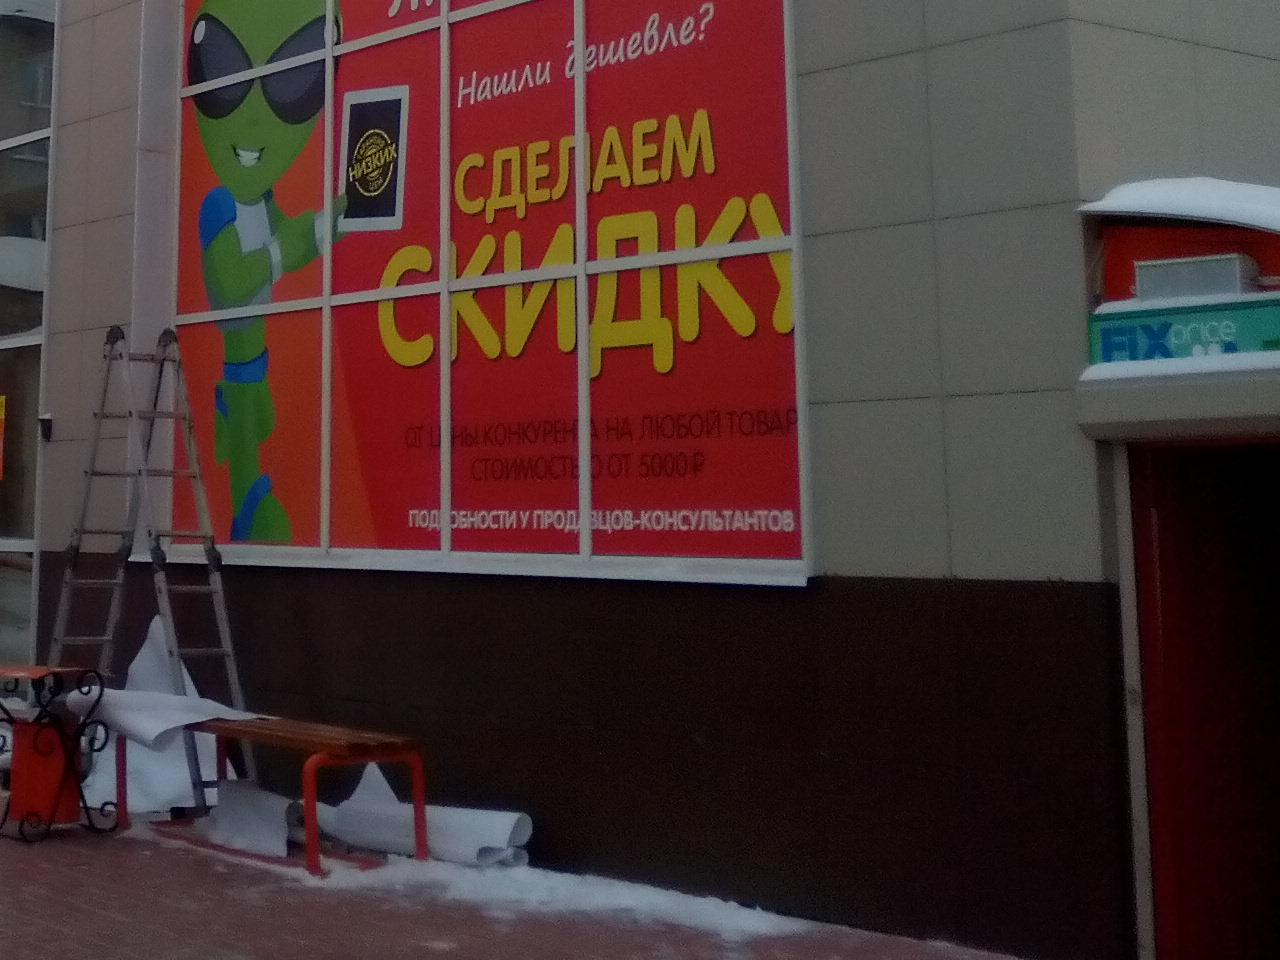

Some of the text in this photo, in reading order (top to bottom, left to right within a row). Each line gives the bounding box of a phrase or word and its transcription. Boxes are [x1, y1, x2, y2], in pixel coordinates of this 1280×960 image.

[457, 2, 714, 108] Нашли дешевле?
[454, 109, 716, 224] СДЕЛАЕМ
[605, 414, 632, 441] НА
[639, 407, 720, 441] ЛЮБОЙ
[608, 452, 632, 479] ОТ
[519, 510, 531, 530] У
